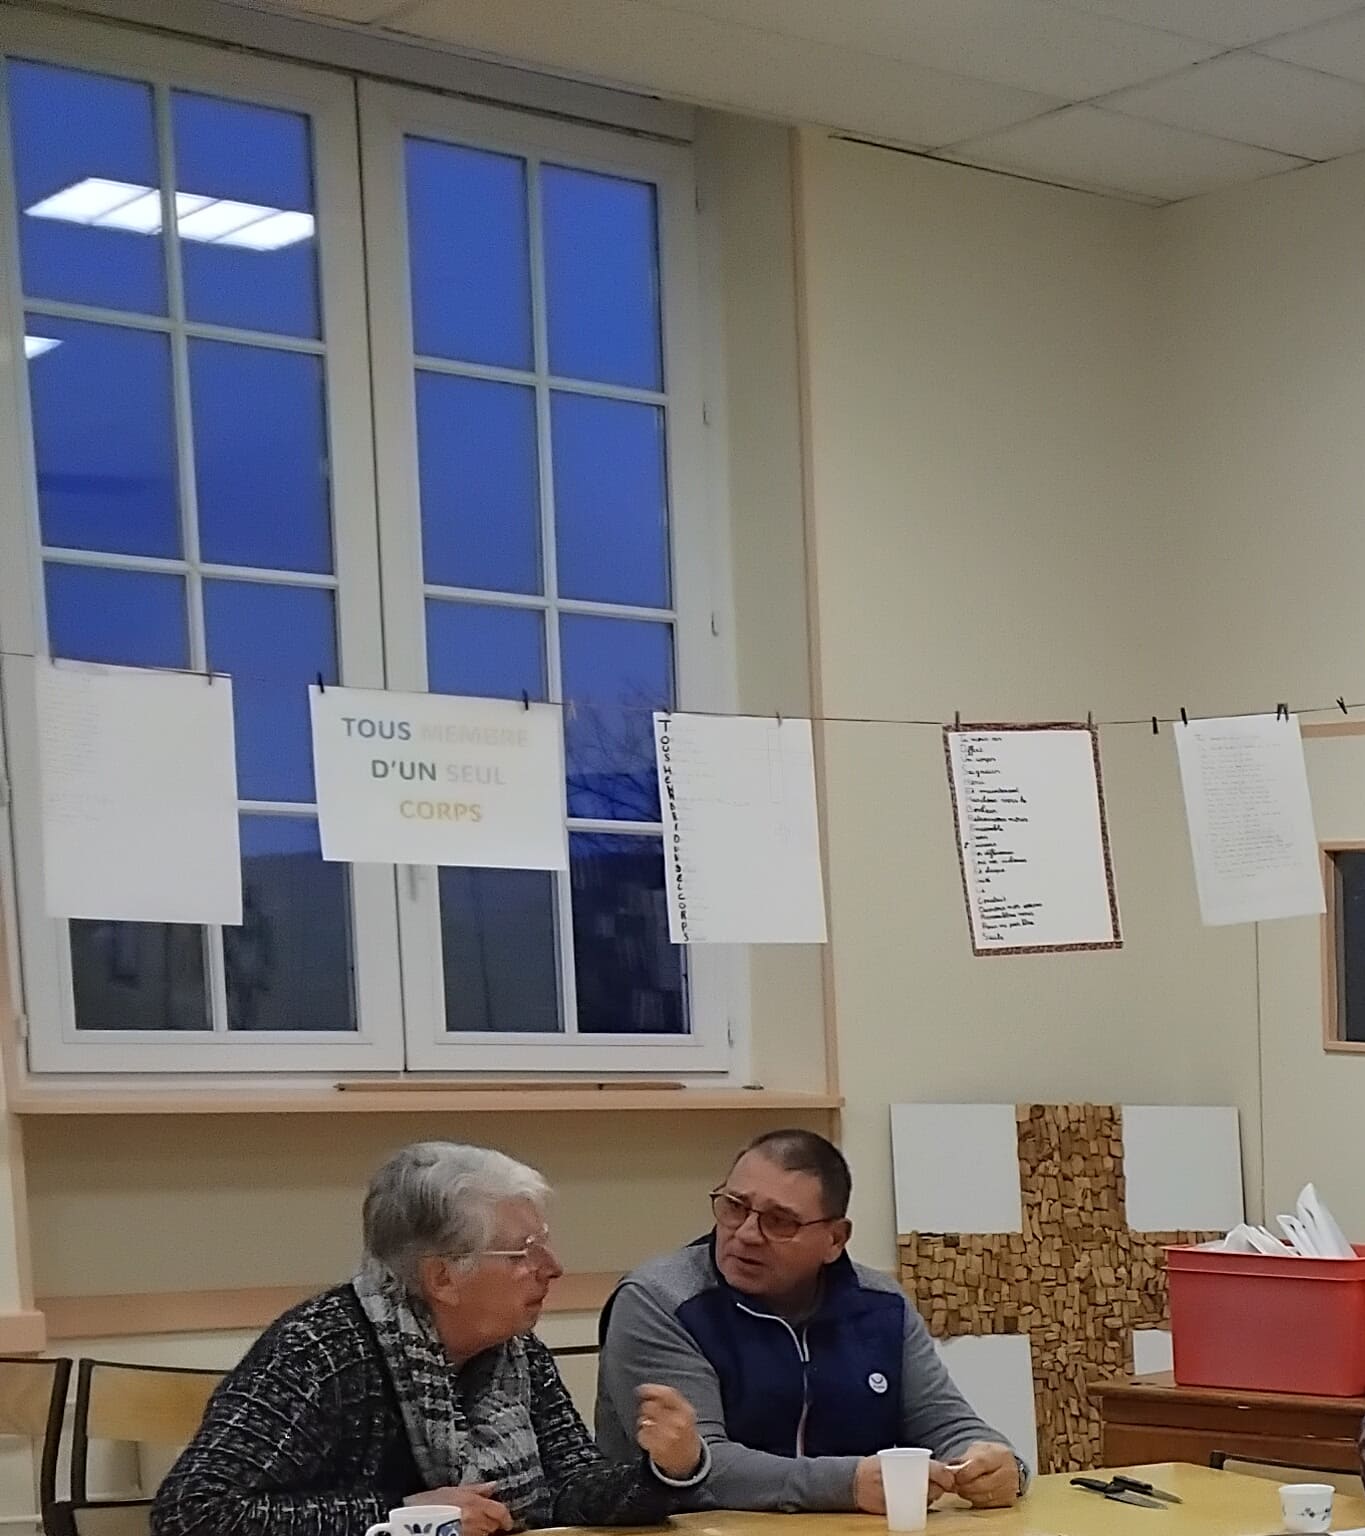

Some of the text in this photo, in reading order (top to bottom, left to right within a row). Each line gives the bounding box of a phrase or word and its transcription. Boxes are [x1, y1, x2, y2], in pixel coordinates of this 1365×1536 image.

[341, 717, 529, 748] TOUS MEMBRE
[371, 759, 506, 785] D'UN SEUL
[400, 800, 483, 823] CORPS
